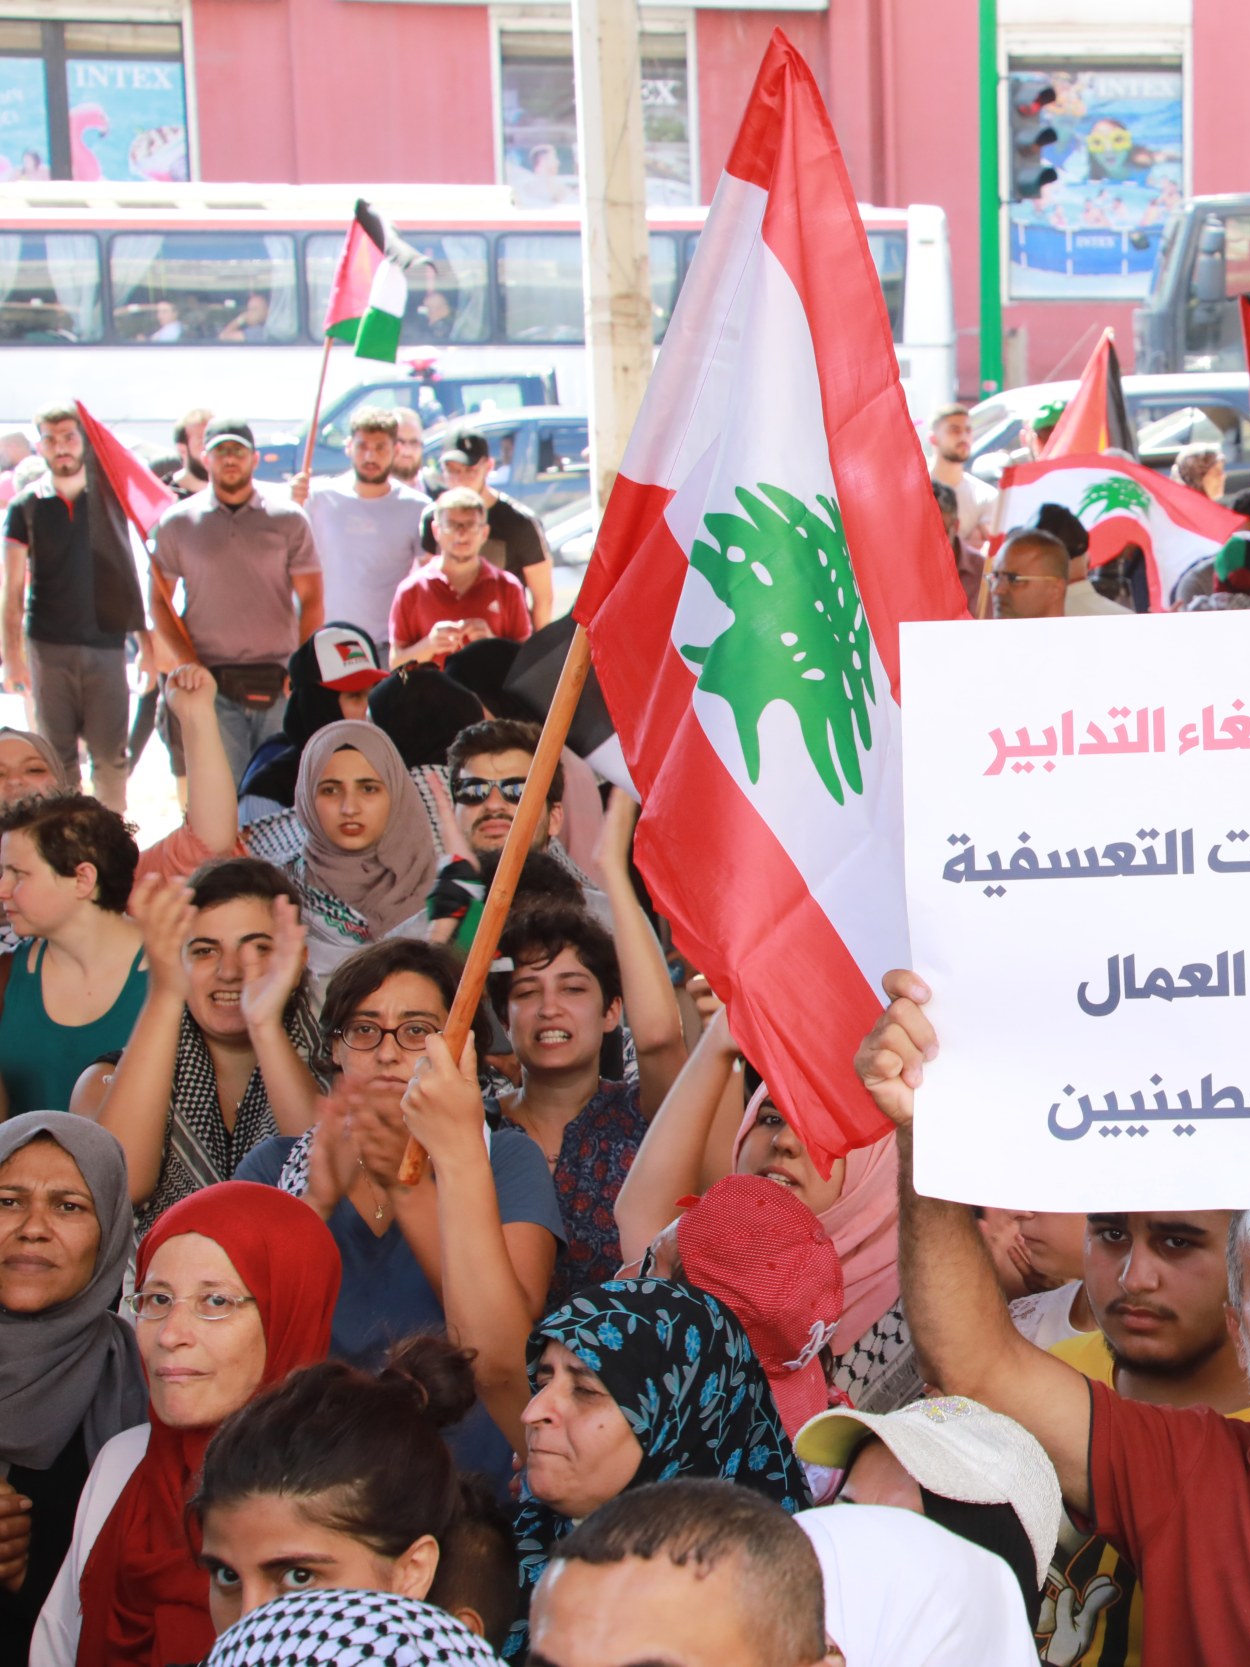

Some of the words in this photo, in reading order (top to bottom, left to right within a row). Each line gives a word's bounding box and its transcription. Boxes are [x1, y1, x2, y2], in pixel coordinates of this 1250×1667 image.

[75, 64, 174, 90] INTEX
[983, 706, 1166, 776] التدابير
[941, 827, 1195, 899] التعسفية
[1076, 949, 1247, 1018] العمال
